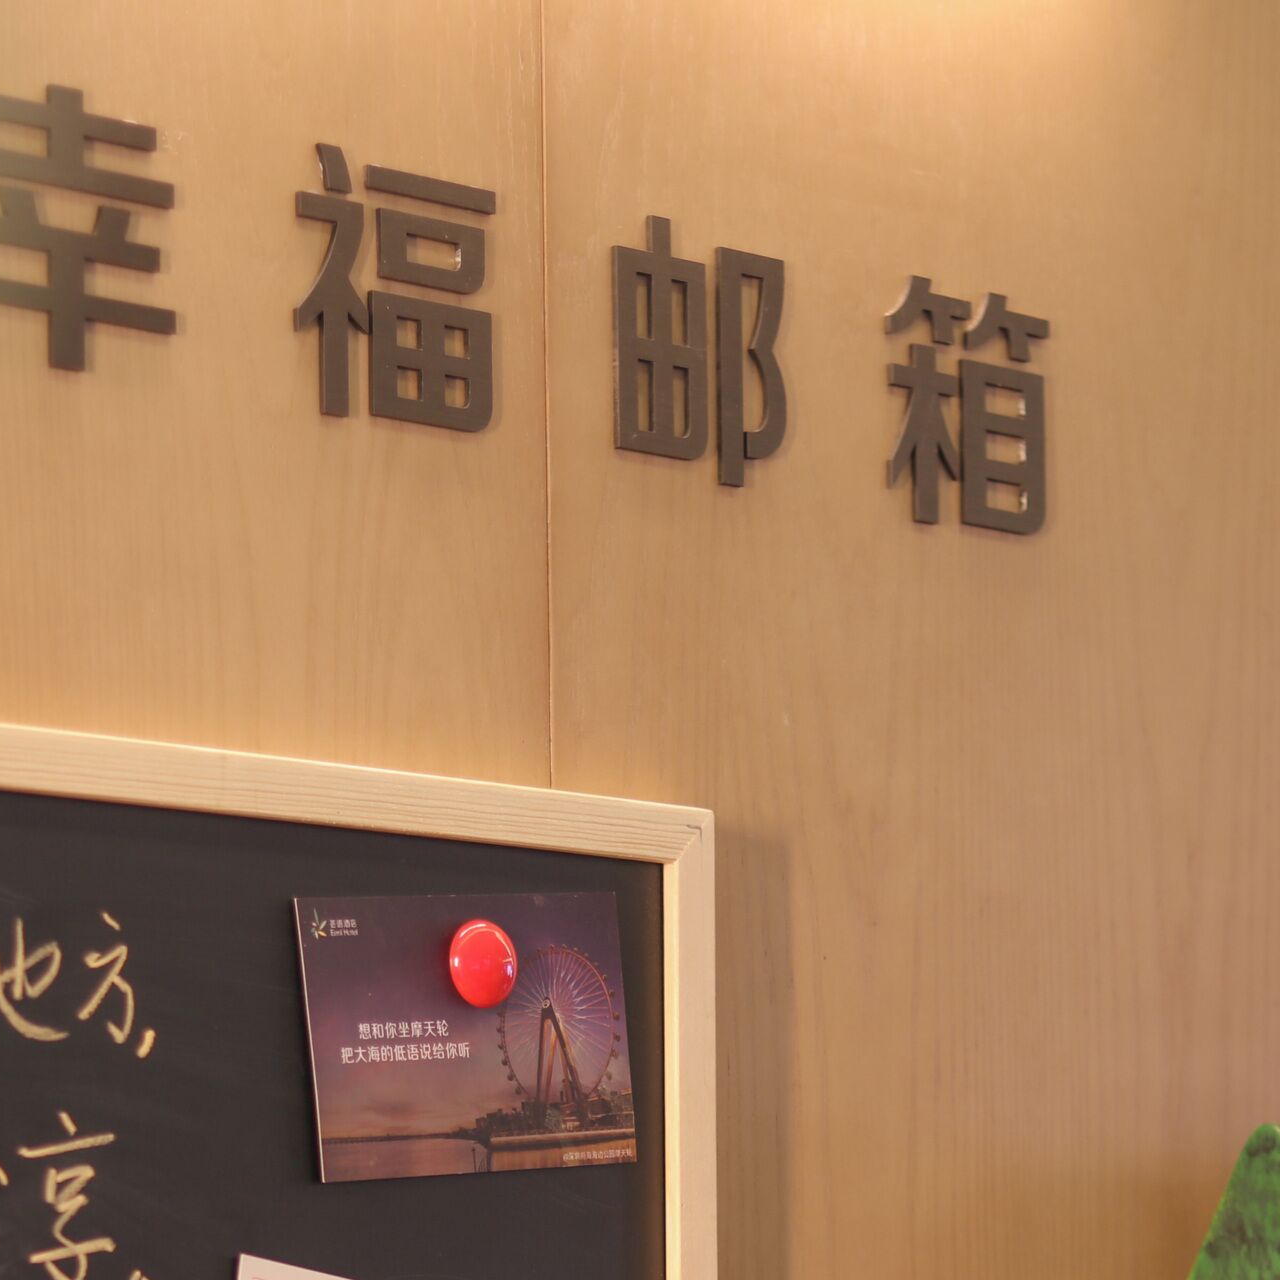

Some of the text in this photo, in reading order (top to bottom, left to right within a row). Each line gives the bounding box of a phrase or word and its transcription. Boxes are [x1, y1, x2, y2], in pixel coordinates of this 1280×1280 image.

[358, 1019, 449, 1040] 想和你坐摩天轮
[340, 1042, 470, 1064] 把大海的低语说给你听
